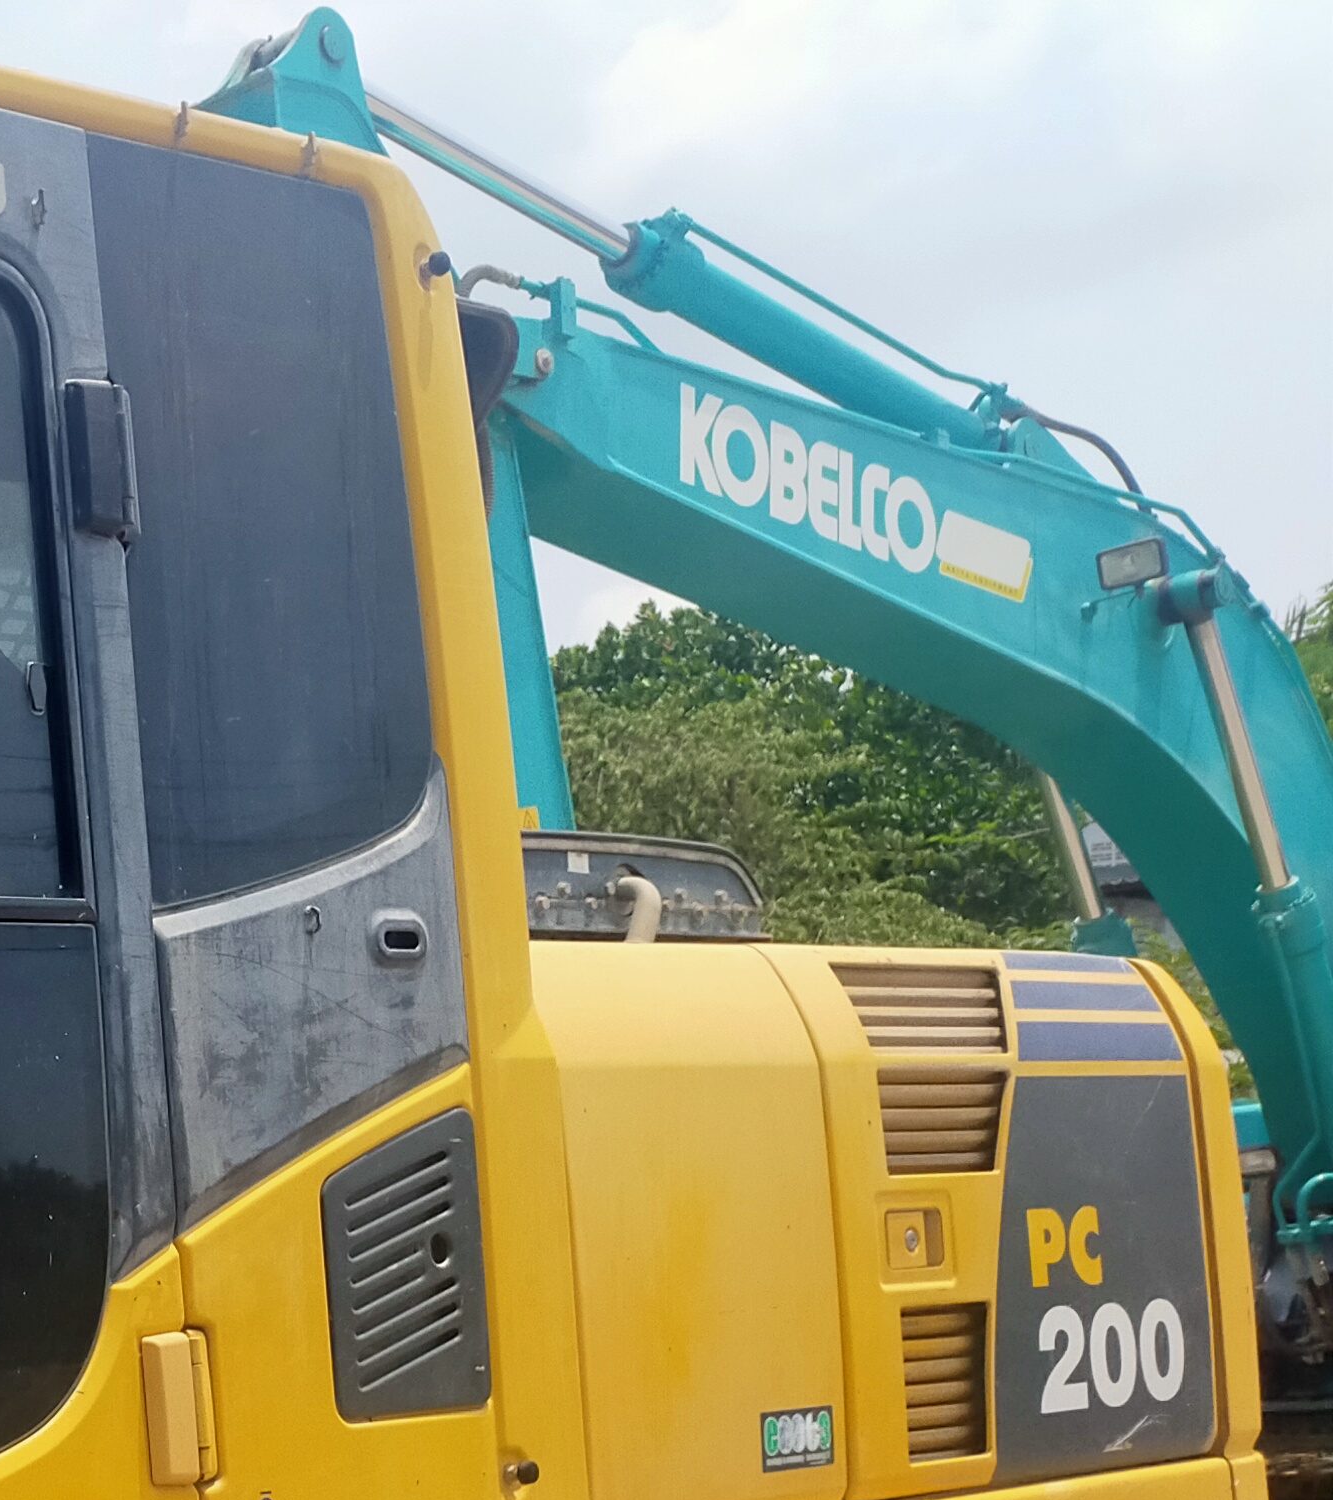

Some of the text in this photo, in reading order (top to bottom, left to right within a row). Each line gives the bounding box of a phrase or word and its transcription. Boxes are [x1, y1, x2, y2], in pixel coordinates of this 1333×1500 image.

[680, 382, 936, 573] KOBELCO
[1026, 1205, 1103, 1287] PC
[1039, 1298, 1185, 1414] 200
